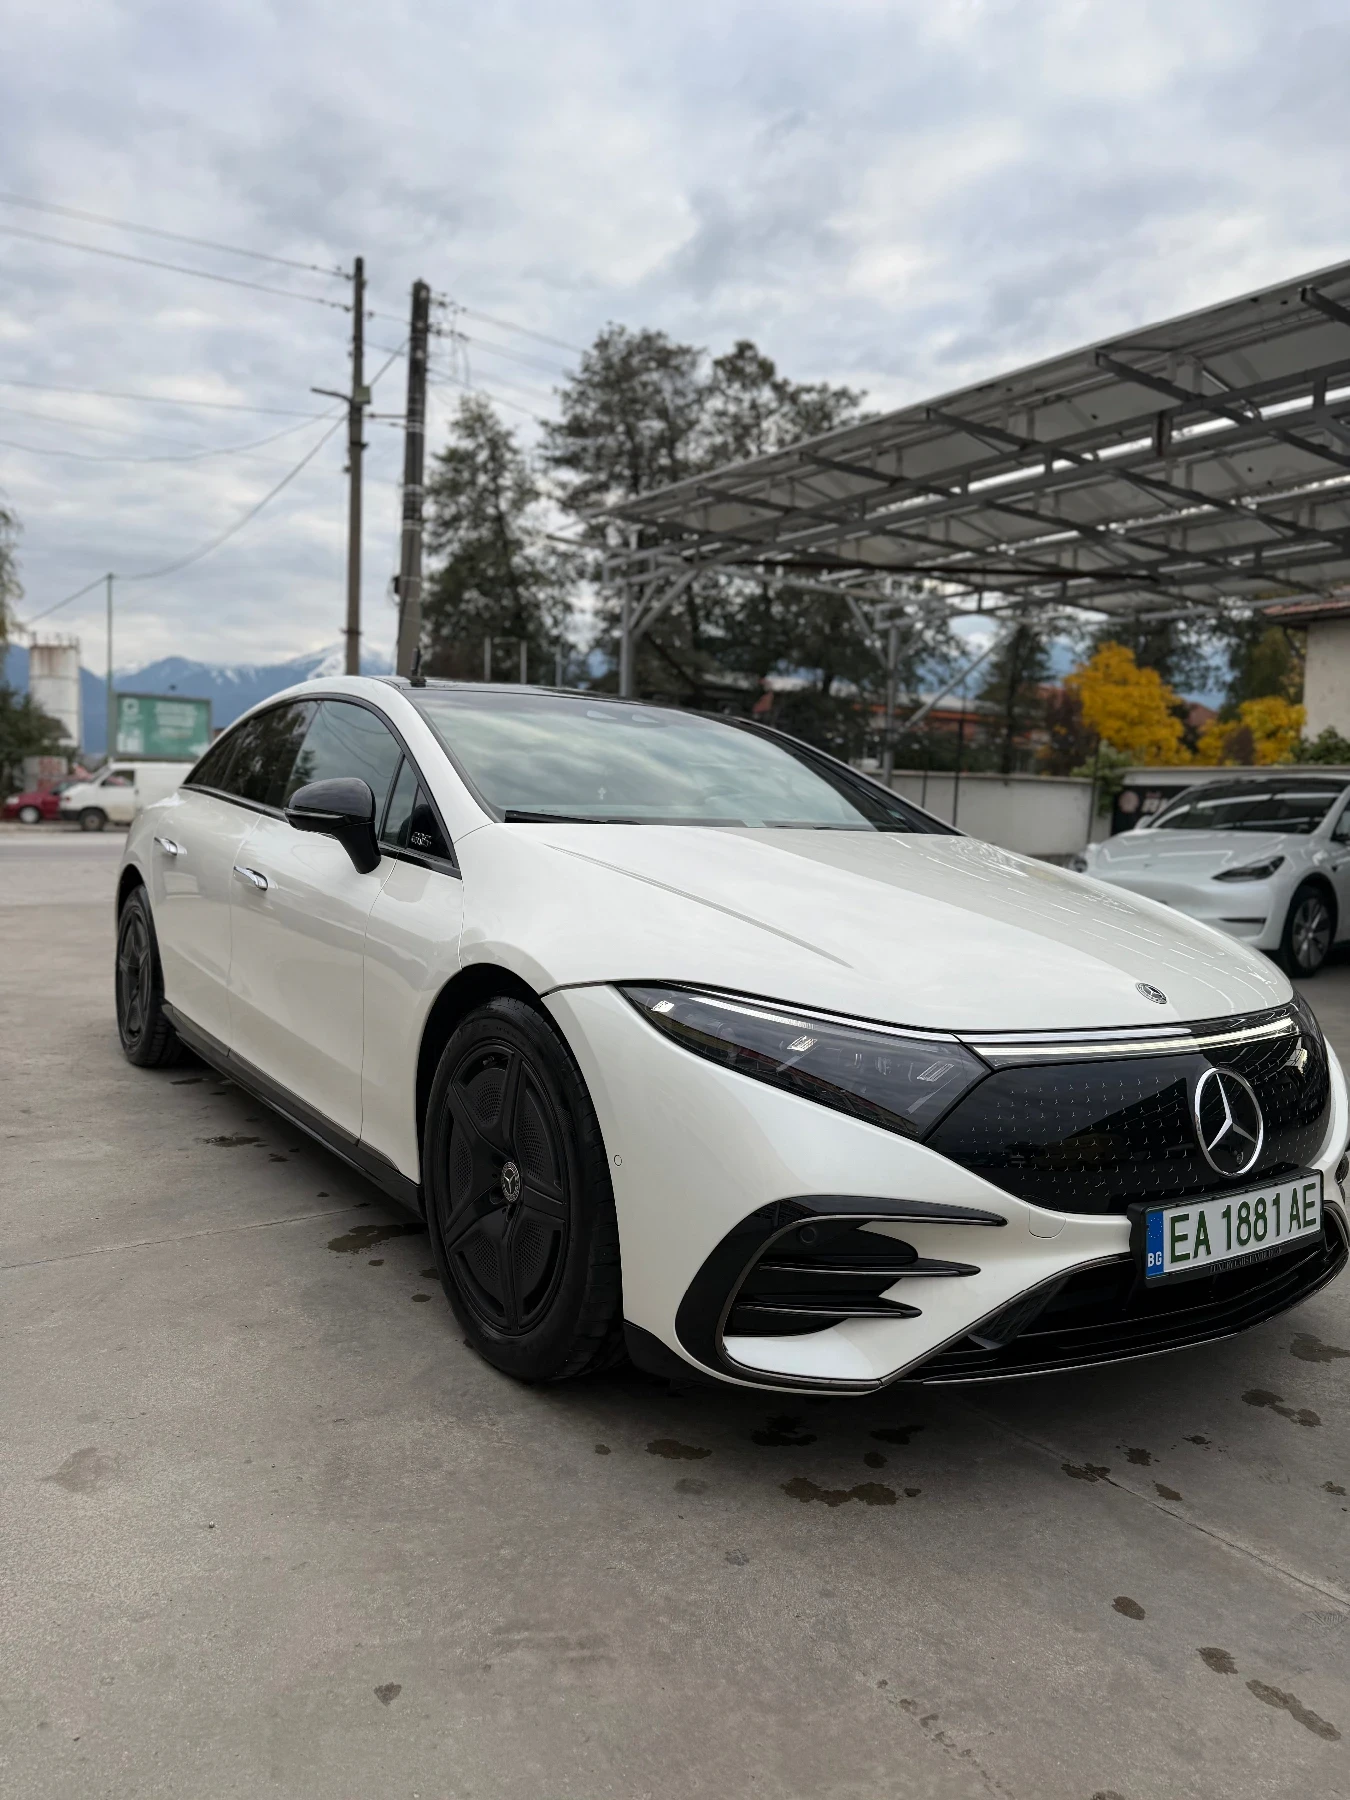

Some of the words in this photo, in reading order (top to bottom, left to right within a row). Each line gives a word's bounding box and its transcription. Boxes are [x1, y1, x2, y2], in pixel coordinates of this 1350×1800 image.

[1170, 1210, 1211, 1263] EA
[1221, 1192, 1281, 1251] 1881
[1288, 1182, 1316, 1233] AE
[1147, 1252, 1162, 1267] BG
